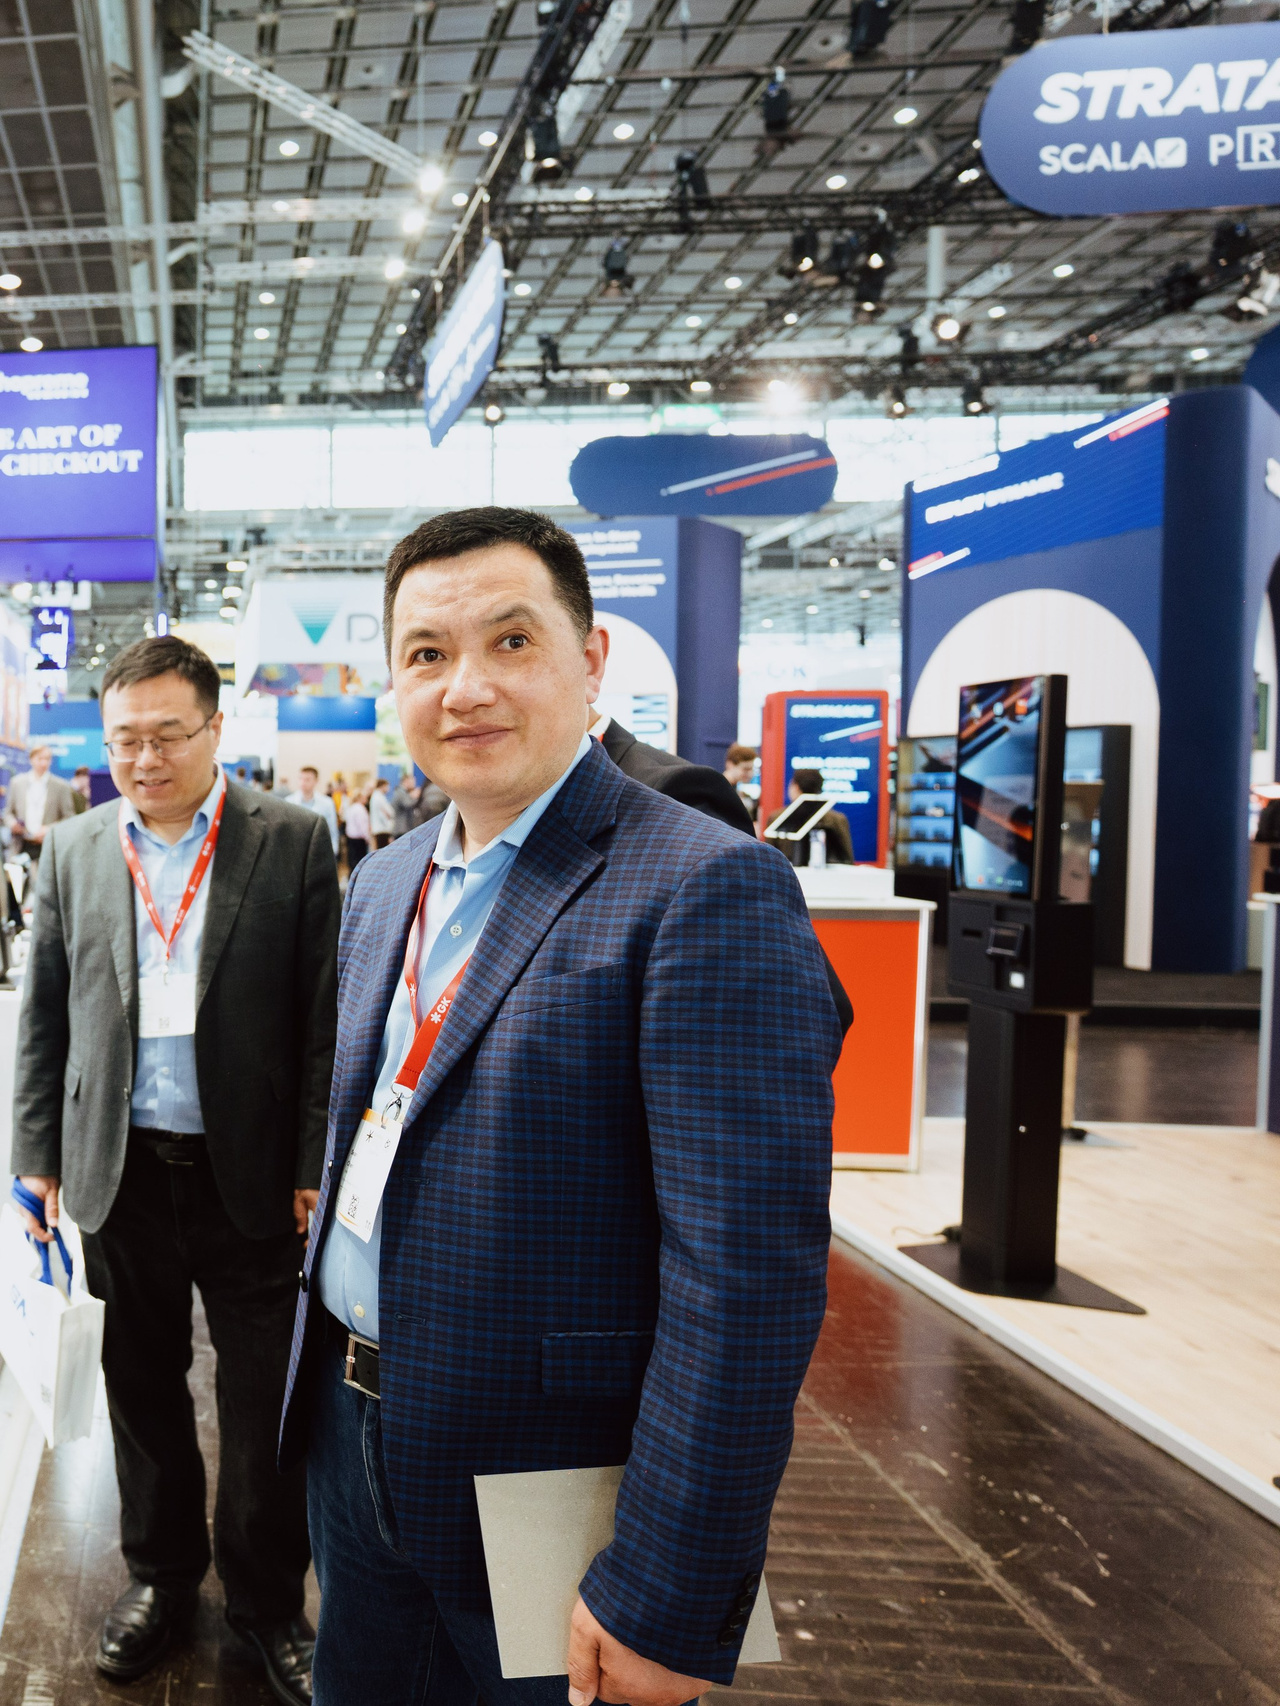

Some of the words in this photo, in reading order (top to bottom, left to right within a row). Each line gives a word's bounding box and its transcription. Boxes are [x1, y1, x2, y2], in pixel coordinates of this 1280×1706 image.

[1039, 140, 1157, 176] SCALA
[16, 426, 78, 450] ART
[79, 424, 123, 448] OF
